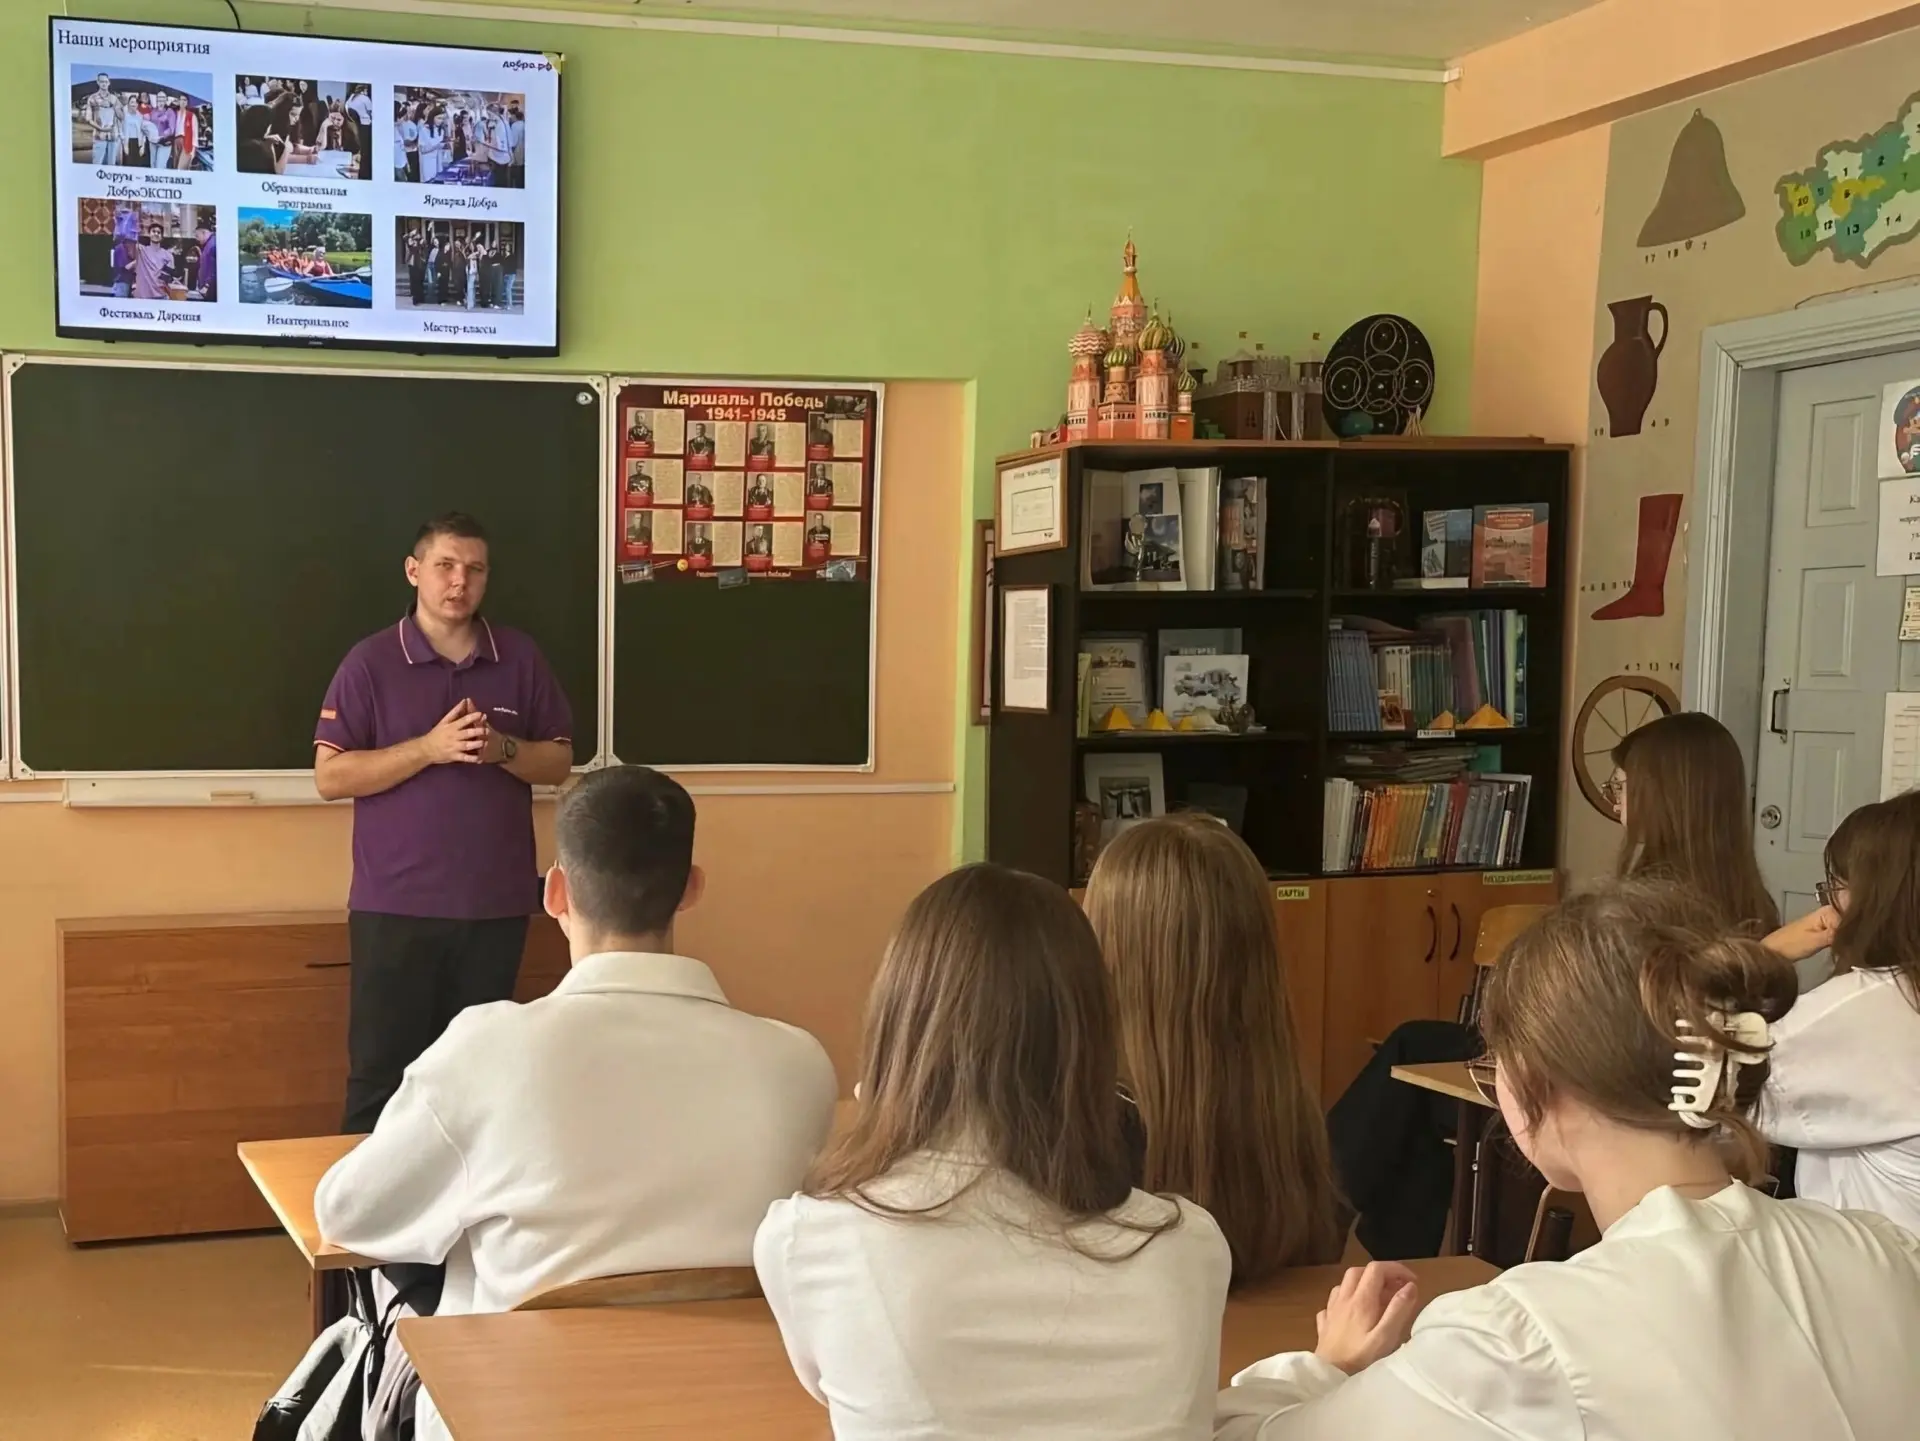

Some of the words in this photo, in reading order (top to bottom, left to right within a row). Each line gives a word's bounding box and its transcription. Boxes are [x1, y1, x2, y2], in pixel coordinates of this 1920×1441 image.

[58, 29, 104, 47] Наши
[109, 36, 211, 55] мероприятия
[96, 169, 133, 186] Форум
[144, 174, 193, 186] выставка
[1843, 167, 1848, 177] 1
[107, 185, 182, 200] ДоброЭКСПО
[261, 181, 348, 197] Образовательная
[277, 199, 333, 210] программа
[423, 194, 466, 208] Ярмарка
[467, 197, 498, 210] Добра
[99, 307, 155, 321] Фестиваль
[156, 309, 202, 323] Дарения
[266, 313, 350, 329] Нематериальное
[423, 321, 497, 335] Мастер-классы
[662, 390, 755, 408] Маршалы
[705, 407, 787, 421] 1941-1945
